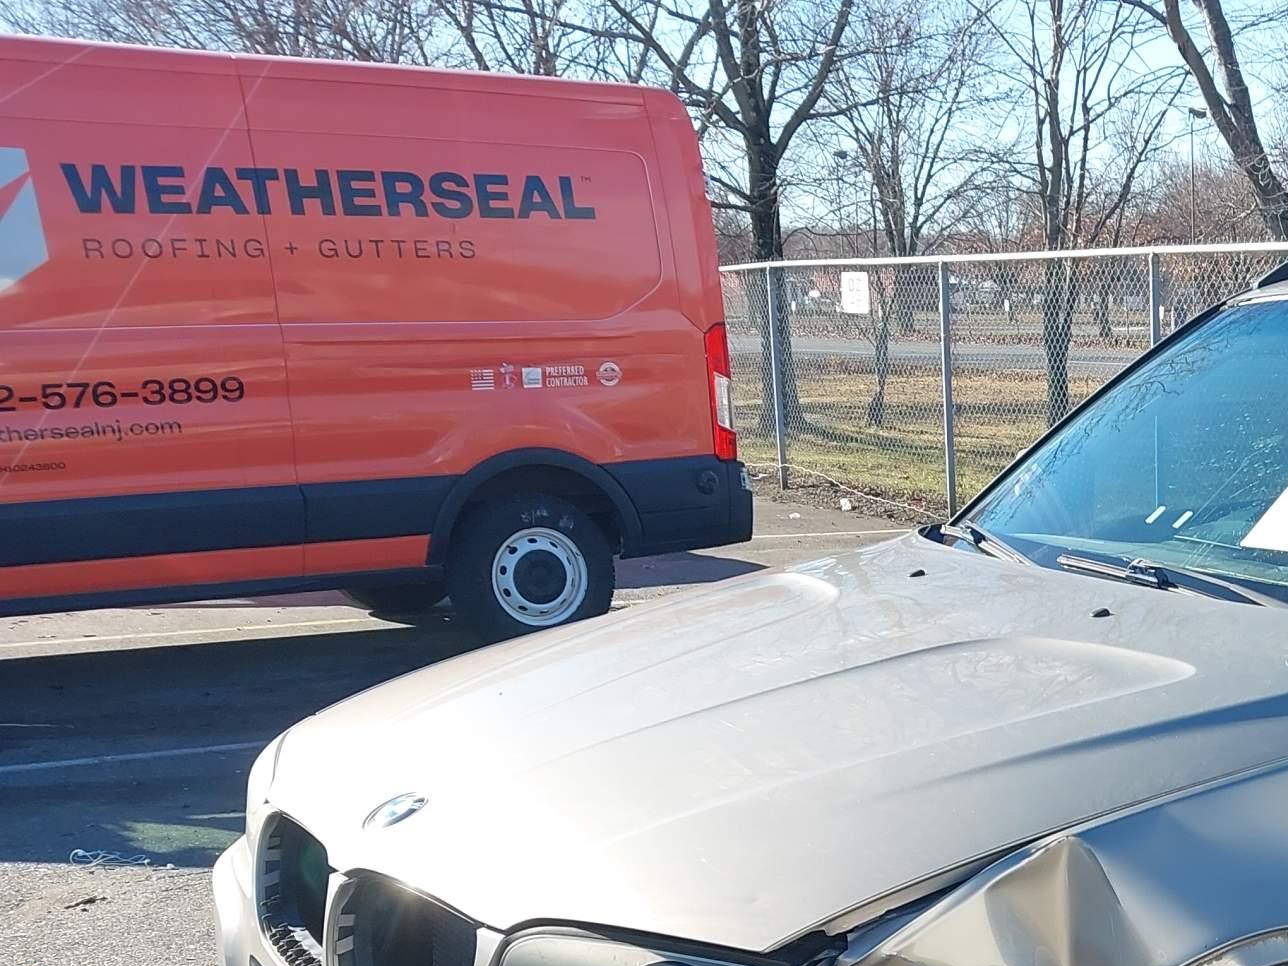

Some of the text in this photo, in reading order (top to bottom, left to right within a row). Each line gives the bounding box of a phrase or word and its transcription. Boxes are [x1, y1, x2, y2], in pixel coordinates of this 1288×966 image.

[60, 163, 595, 219] WEATHERSEAL
[84, 237, 478, 260] ROOFING + GUTTERS
[545, 365, 585, 376] PREFERRED
[545, 375, 588, 387] CONTRACTOR
[0, 376, 244, 412] 2-576-3899
